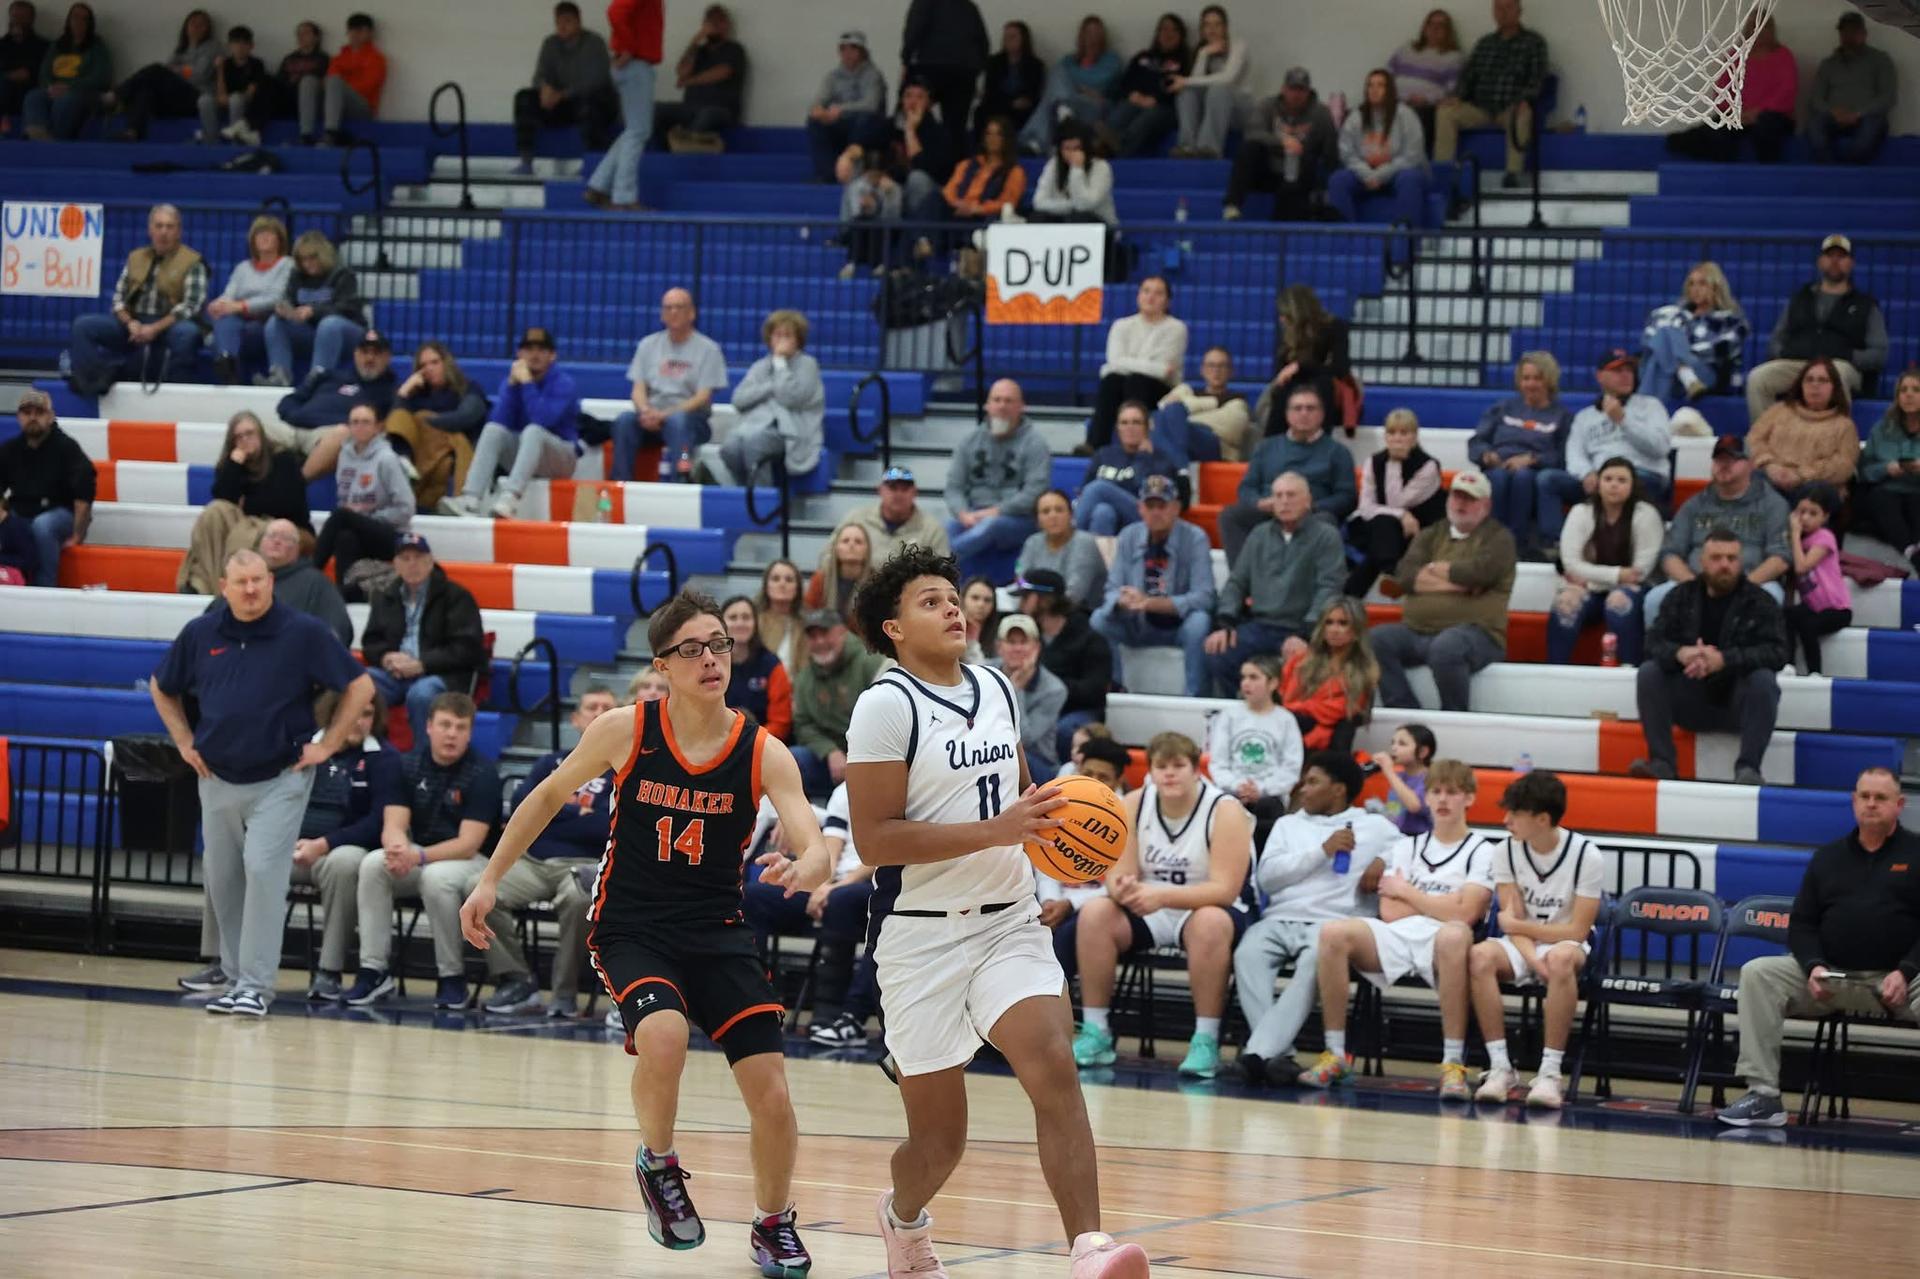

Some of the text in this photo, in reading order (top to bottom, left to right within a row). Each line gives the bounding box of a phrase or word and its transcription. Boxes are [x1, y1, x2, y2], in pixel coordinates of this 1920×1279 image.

[4, 204, 103, 239] UNION
[1005, 245, 1090, 286] D-UP
[945, 739, 1014, 770] Union
[636, 780, 734, 814] HONAKER
[976, 772, 1001, 821] 11
[656, 816, 705, 866] 14
[1054, 836, 1109, 876] Wilson
[1630, 901, 1709, 921] UNION
[1745, 909, 1790, 928] UNI
